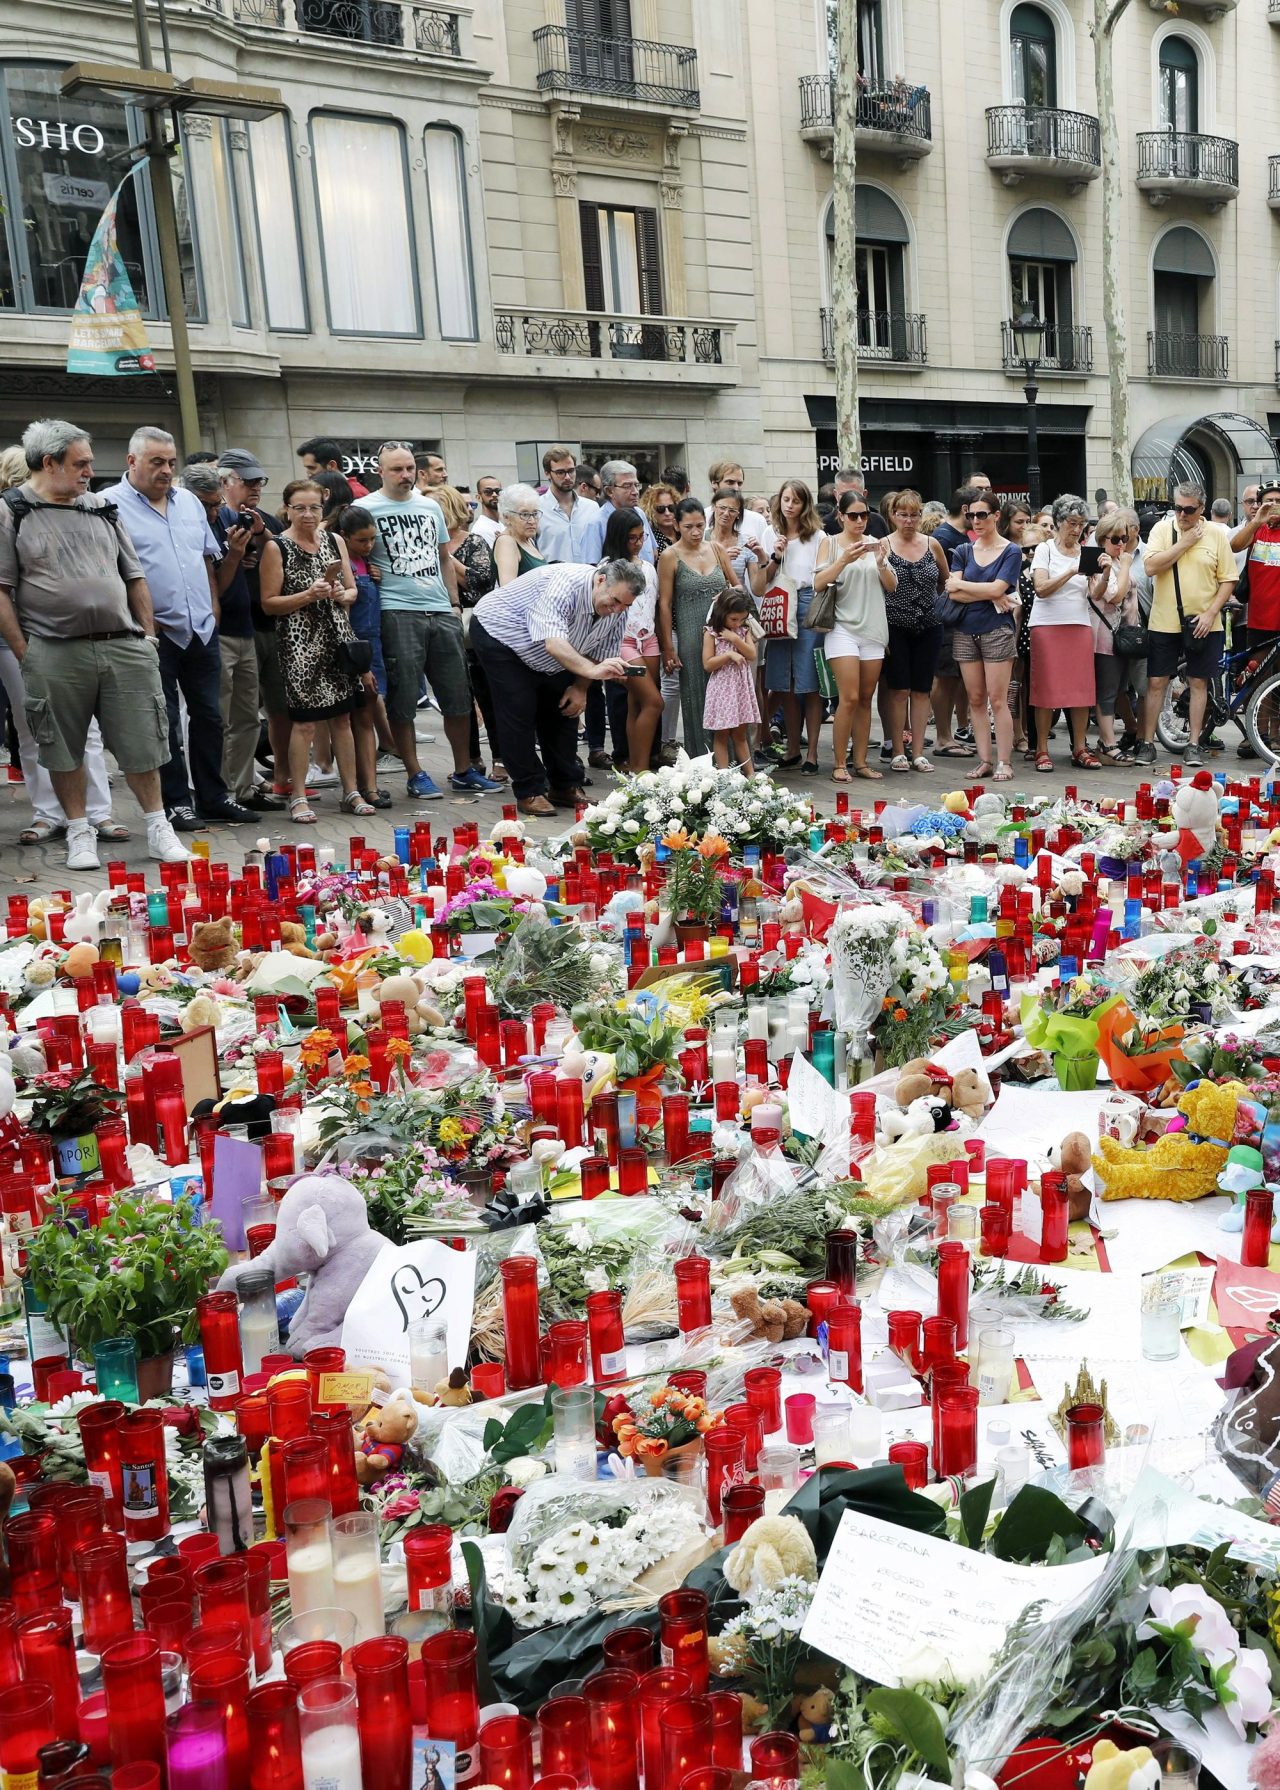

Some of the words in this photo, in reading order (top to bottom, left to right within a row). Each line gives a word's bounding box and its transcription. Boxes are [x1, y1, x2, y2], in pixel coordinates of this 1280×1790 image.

[10, 117, 104, 153] SHO
[816, 456, 913, 472] PRGFIELD
[760, 606, 784, 620] CASA
